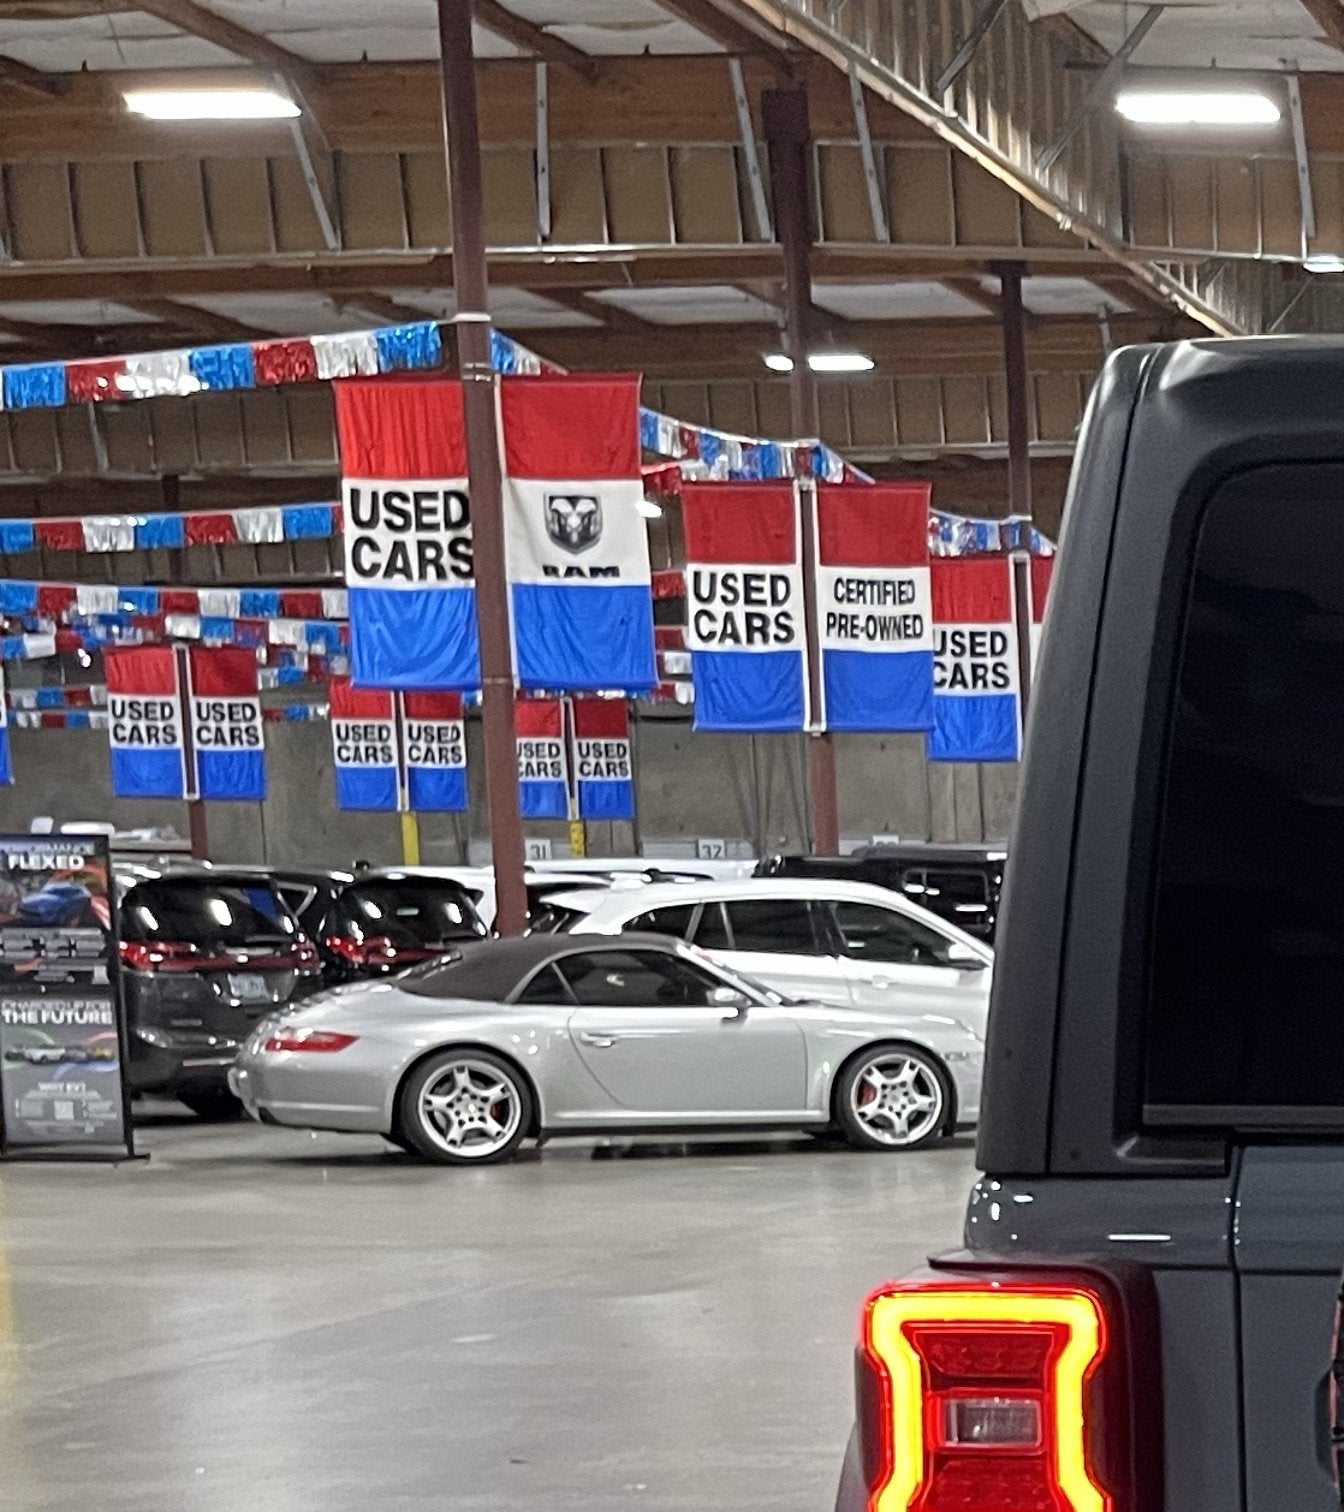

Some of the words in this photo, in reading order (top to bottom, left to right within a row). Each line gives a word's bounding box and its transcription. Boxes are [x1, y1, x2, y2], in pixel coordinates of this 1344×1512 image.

[350, 488, 471, 533] USED
[352, 536, 474, 582] CARS
[542, 564, 620, 578] RAM
[693, 571, 791, 608] USED
[833, 577, 915, 605] CERTIFIED
[694, 610, 795, 646] CARS
[826, 612, 924, 641] PRE-OWNED
[933, 661, 1010, 689] CARS
[111, 700, 174, 721] USED
[196, 702, 257, 723] USED
[112, 723, 177, 745] CARS
[196, 725, 260, 746] CARS
[336, 723, 391, 743] USED
[408, 723, 460, 744] USED
[337, 744, 393, 764] CARS
[408, 744, 463, 764] CARS
[578, 742, 628, 759] USED
[579, 761, 629, 777] CARS
[8, 853, 85, 870] FLEXED
[2, 1010, 38, 1024] THE
[41, 1010, 113, 1024] FUTURE
